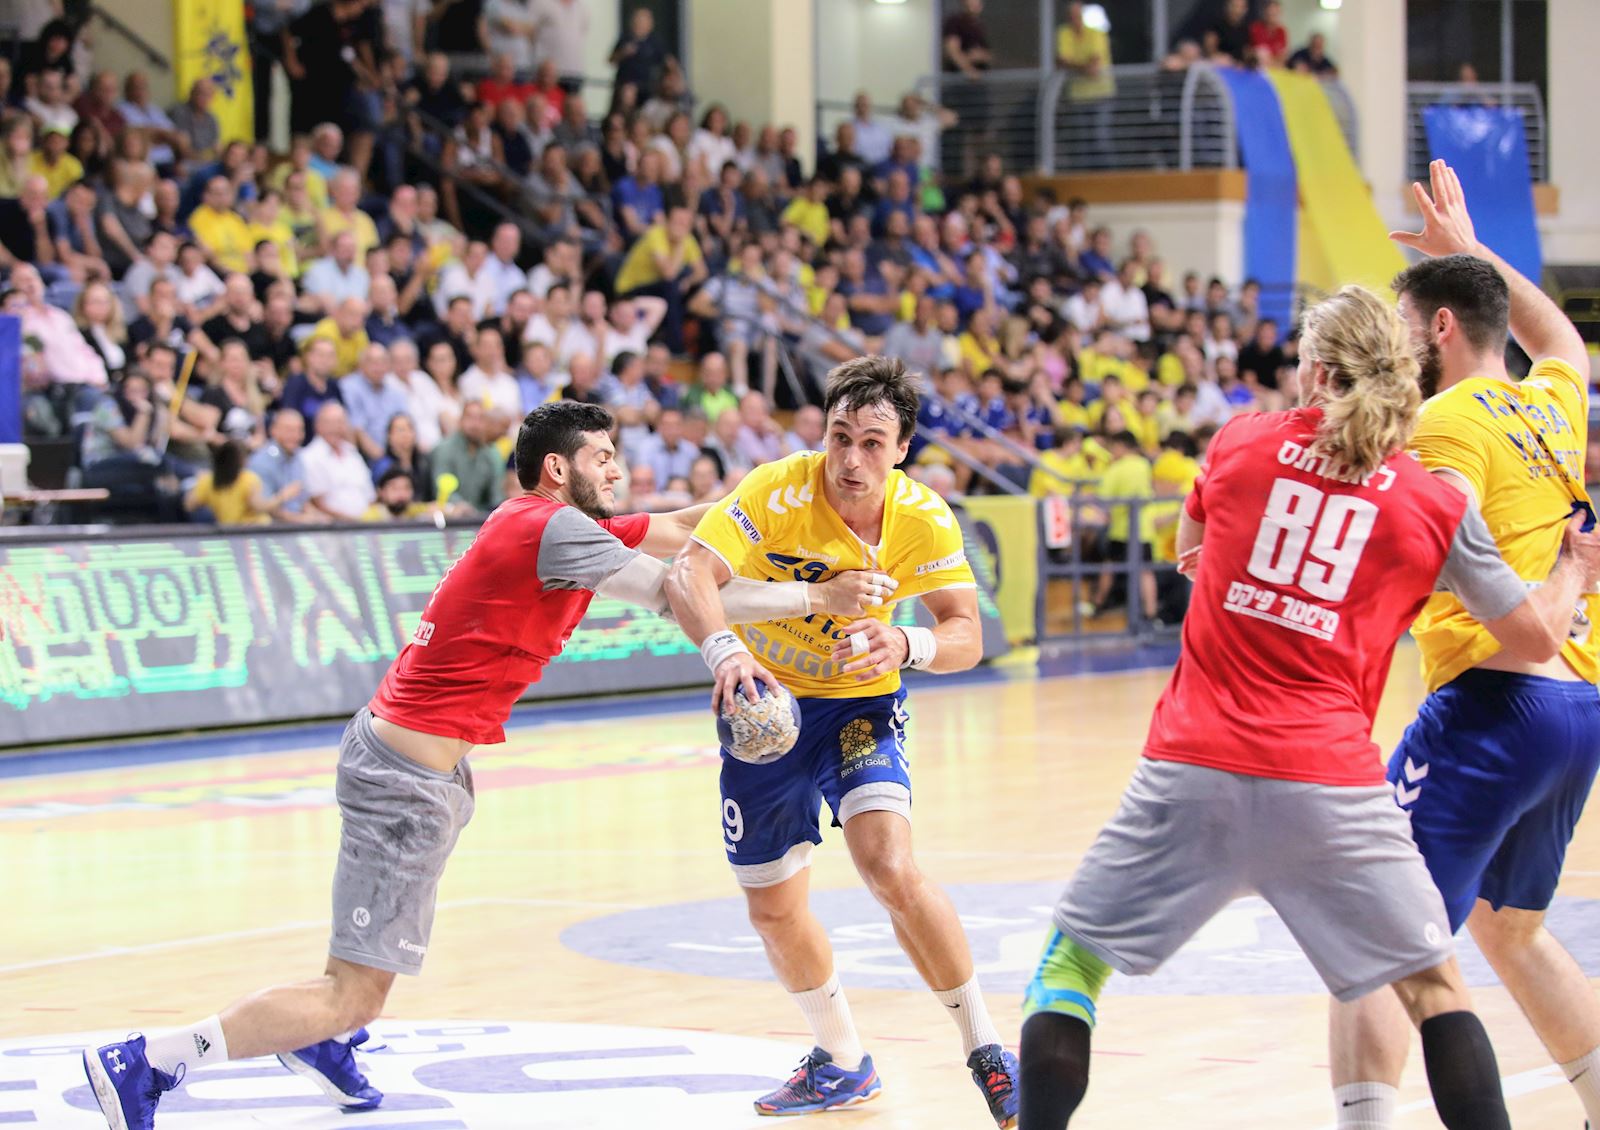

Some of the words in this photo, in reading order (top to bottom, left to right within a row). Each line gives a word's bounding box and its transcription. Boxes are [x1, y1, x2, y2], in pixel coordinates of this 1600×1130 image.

[1247, 477, 1380, 602] 89
[1226, 581, 1277, 611] פיקס
[1281, 594, 1340, 634] מיסטר
[840, 766, 854, 779] Bits
[854, 760, 864, 770] of
[864, 757, 887, 767] Gold
